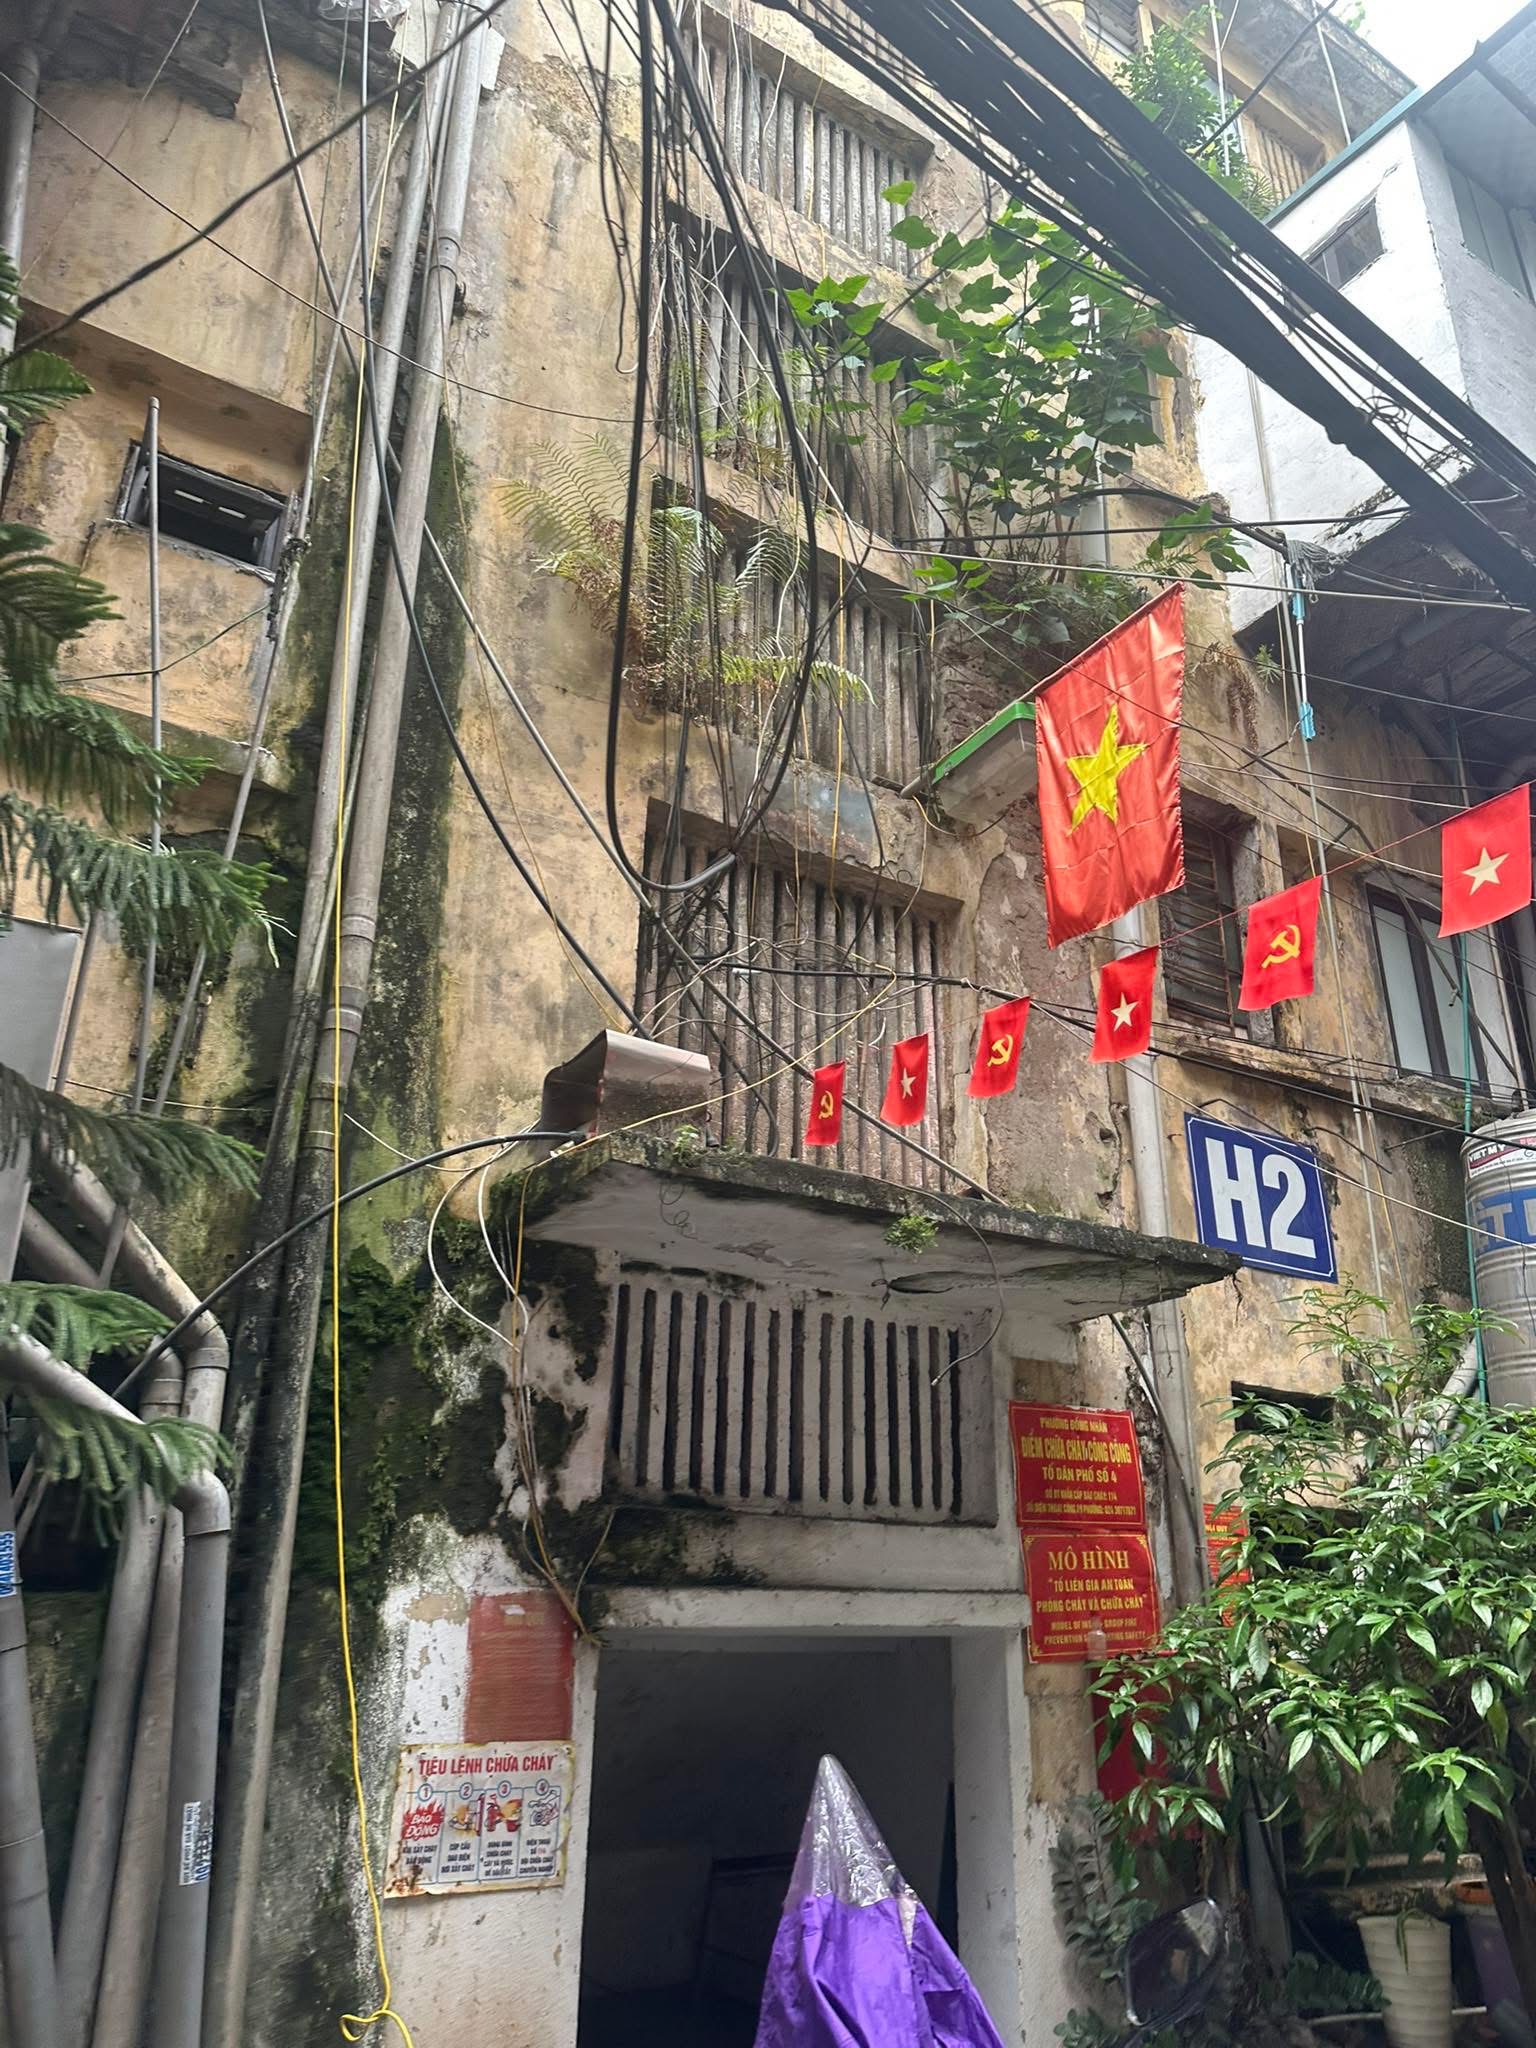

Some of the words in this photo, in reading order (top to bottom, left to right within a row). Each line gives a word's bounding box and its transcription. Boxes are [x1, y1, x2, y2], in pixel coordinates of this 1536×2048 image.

[1205, 1137, 1317, 1259] H2
[1021, 1429, 1044, 1458] ĐIỂM
[1044, 1435, 1066, 1459] CHỮA
[1066, 1436, 1086, 1460] CHÁY
[1088, 1437, 1109, 1462] CÔNG
[1109, 1438, 1132, 1467] CỘNG
[1042, 1463, 1054, 1480] TỔ
[1056, 1465, 1074, 1481] DÂN
[1075, 1464, 1094, 1482] PHỐ
[1096, 1466, 1109, 1483] SỐ
[1110, 1470, 1117, 1483] 4
[1047, 1545, 1078, 1570] MÔ
[1081, 1545, 1130, 1570] HÌNH
[1065, 1577, 1084, 1592] LIÊN
[1085, 1578, 1099, 1591] GIA
[1101, 1578, 1113, 1590] AN
[1114, 1577, 1134, 1590] TOÀN
[1036, 1598, 1064, 1613] PHÒNG
[1065, 1597, 1086, 1611] CHÁY
[1088, 1596, 1099, 1611] VÀ
[1100, 1596, 1123, 1610] CHỮA
[1104, 1618, 1124, 1628] GROUP
[486, 1754, 519, 1773] CHỮA
[523, 1752, 555, 1772] CHÁY
[405, 1825, 439, 1840] ĐỘNG
